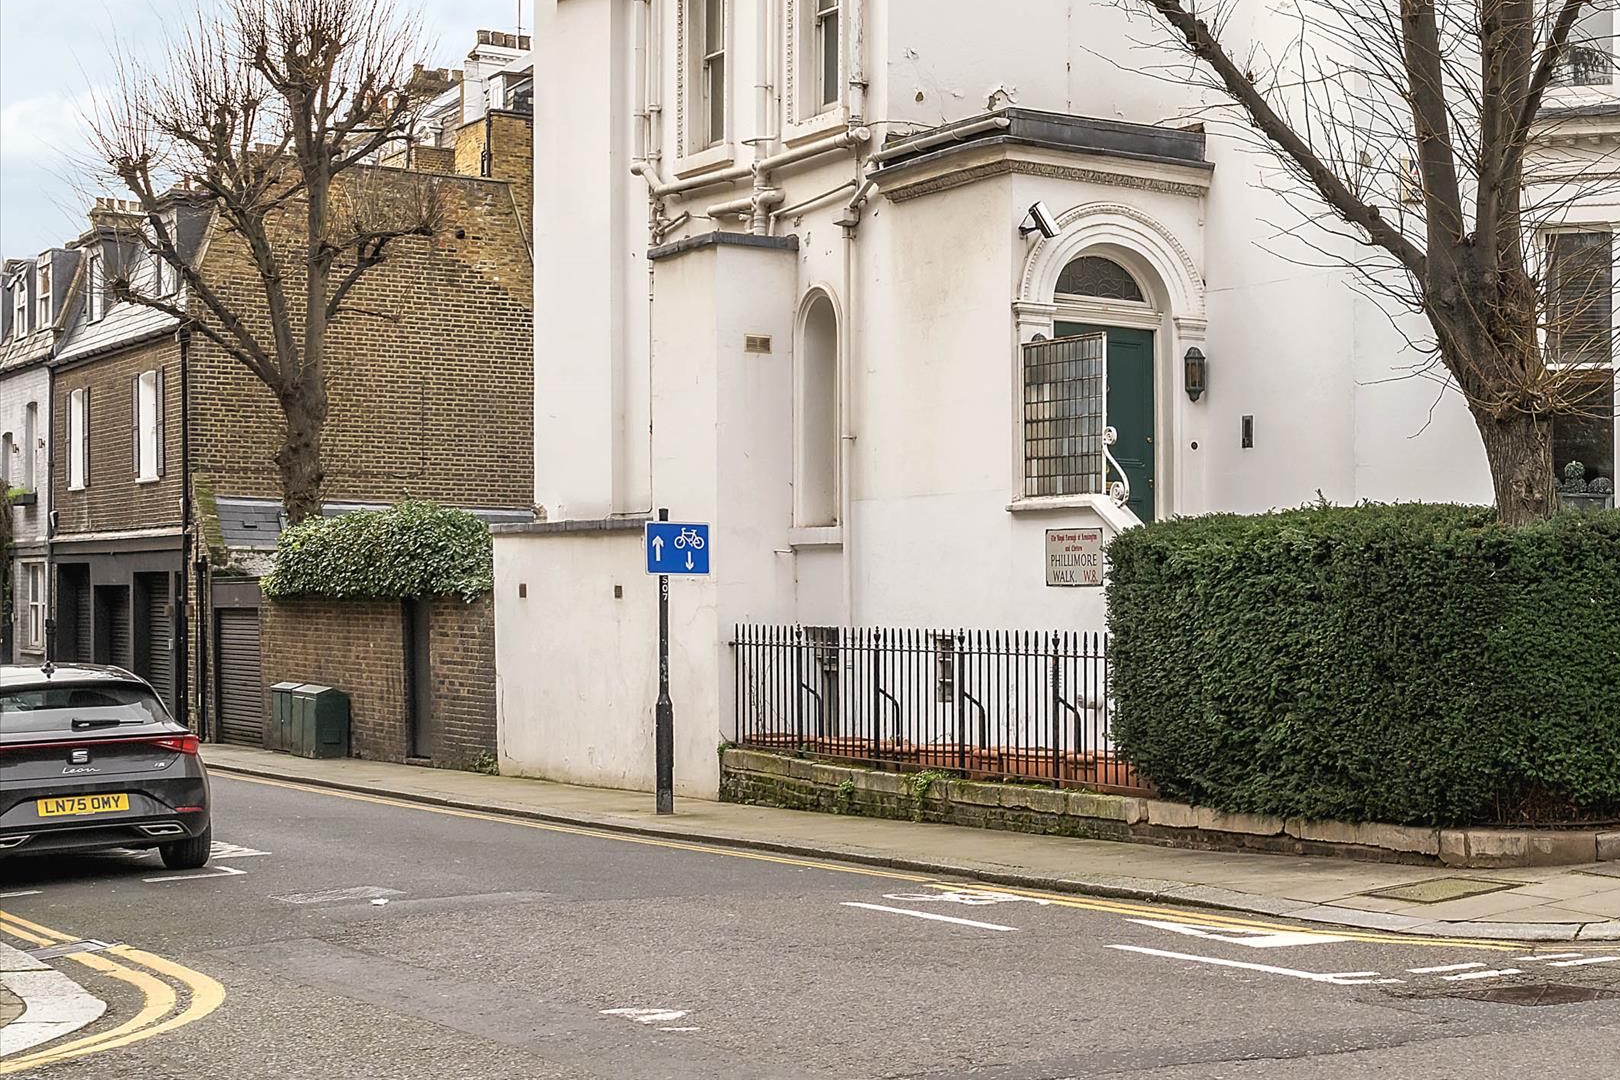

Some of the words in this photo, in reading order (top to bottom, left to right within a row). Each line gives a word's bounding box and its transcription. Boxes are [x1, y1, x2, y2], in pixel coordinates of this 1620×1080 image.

[1051, 554, 1097, 567] PHILLIMORE
[44, 797, 87, 814] LN75
[91, 795, 120, 811] OMY
